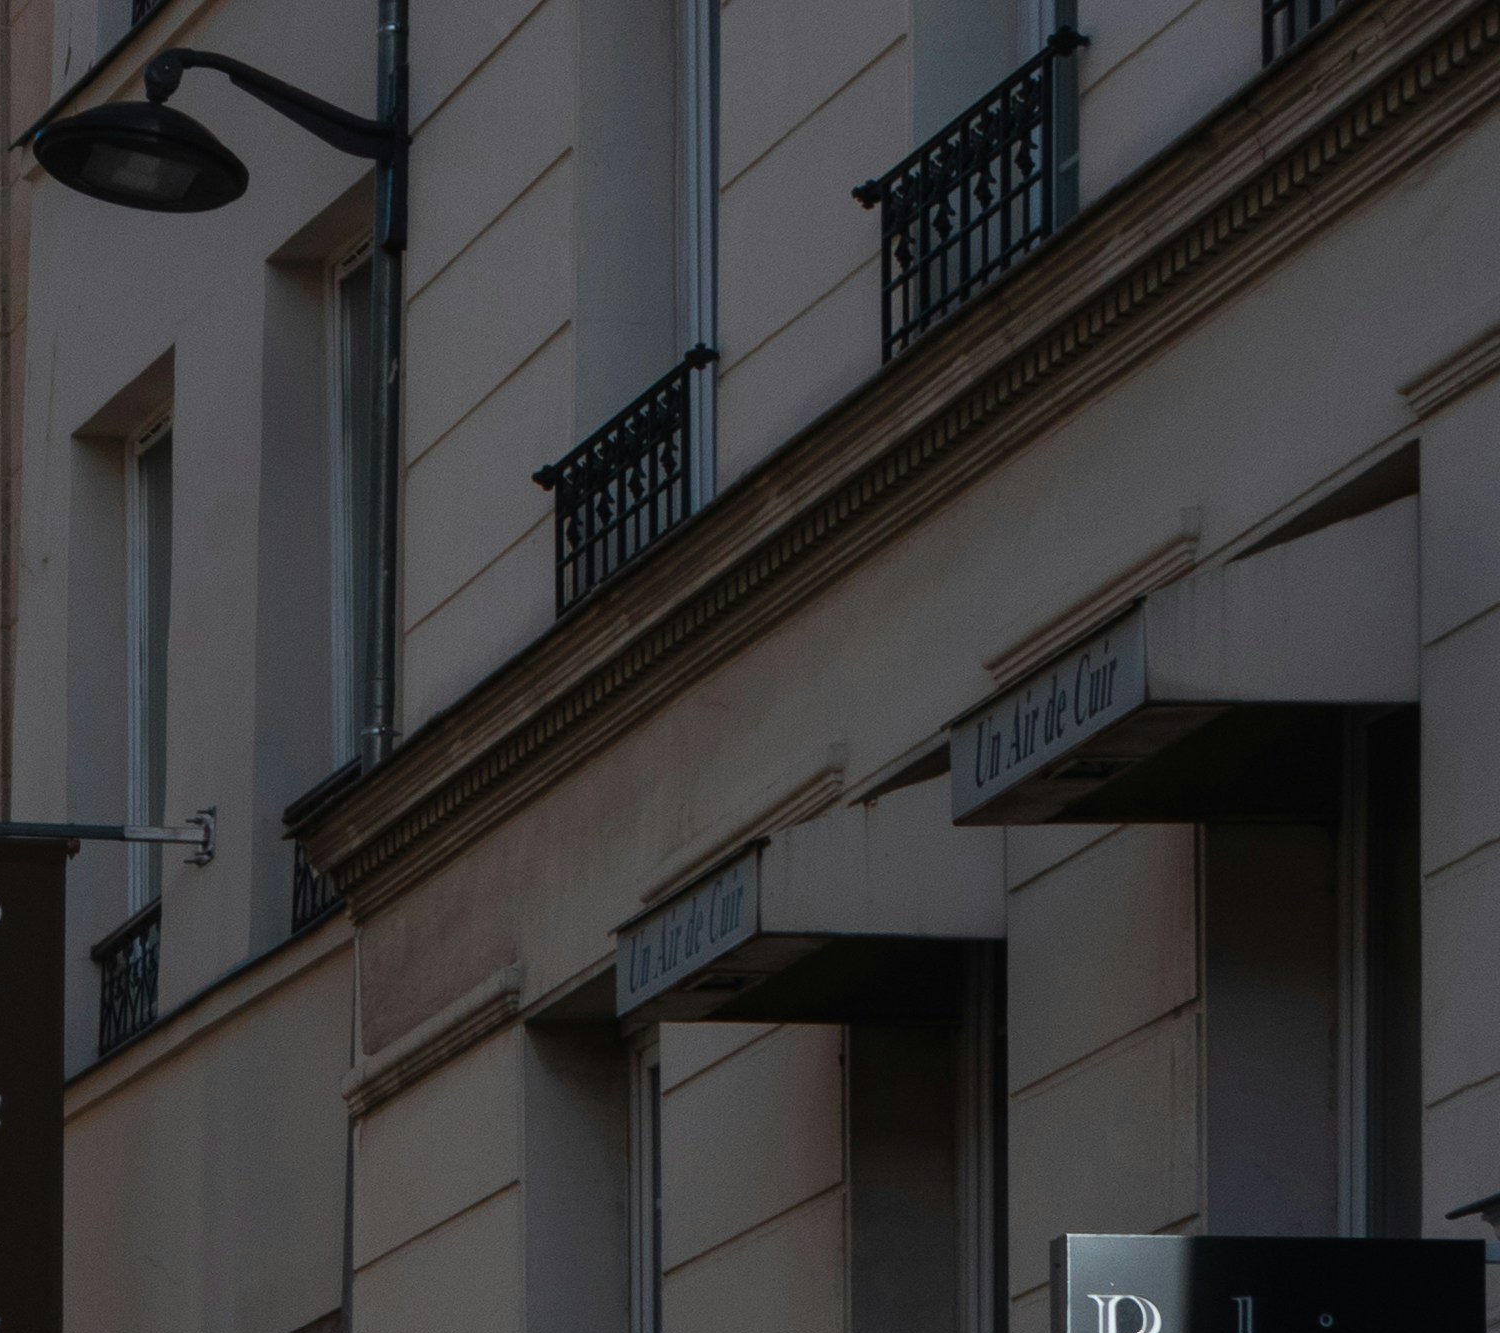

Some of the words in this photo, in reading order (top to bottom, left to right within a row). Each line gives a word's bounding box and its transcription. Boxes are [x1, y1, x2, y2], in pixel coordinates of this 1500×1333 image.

[975, 715, 1001, 788] Un
[1006, 689, 1039, 769] Air
[1044, 671, 1067, 746] de
[1074, 638, 1117, 727] Cuir
[629, 930, 651, 994] Un
[653, 908, 683, 979] Air
[685, 896, 704, 959] de
[709, 868, 744, 944] Cuir
